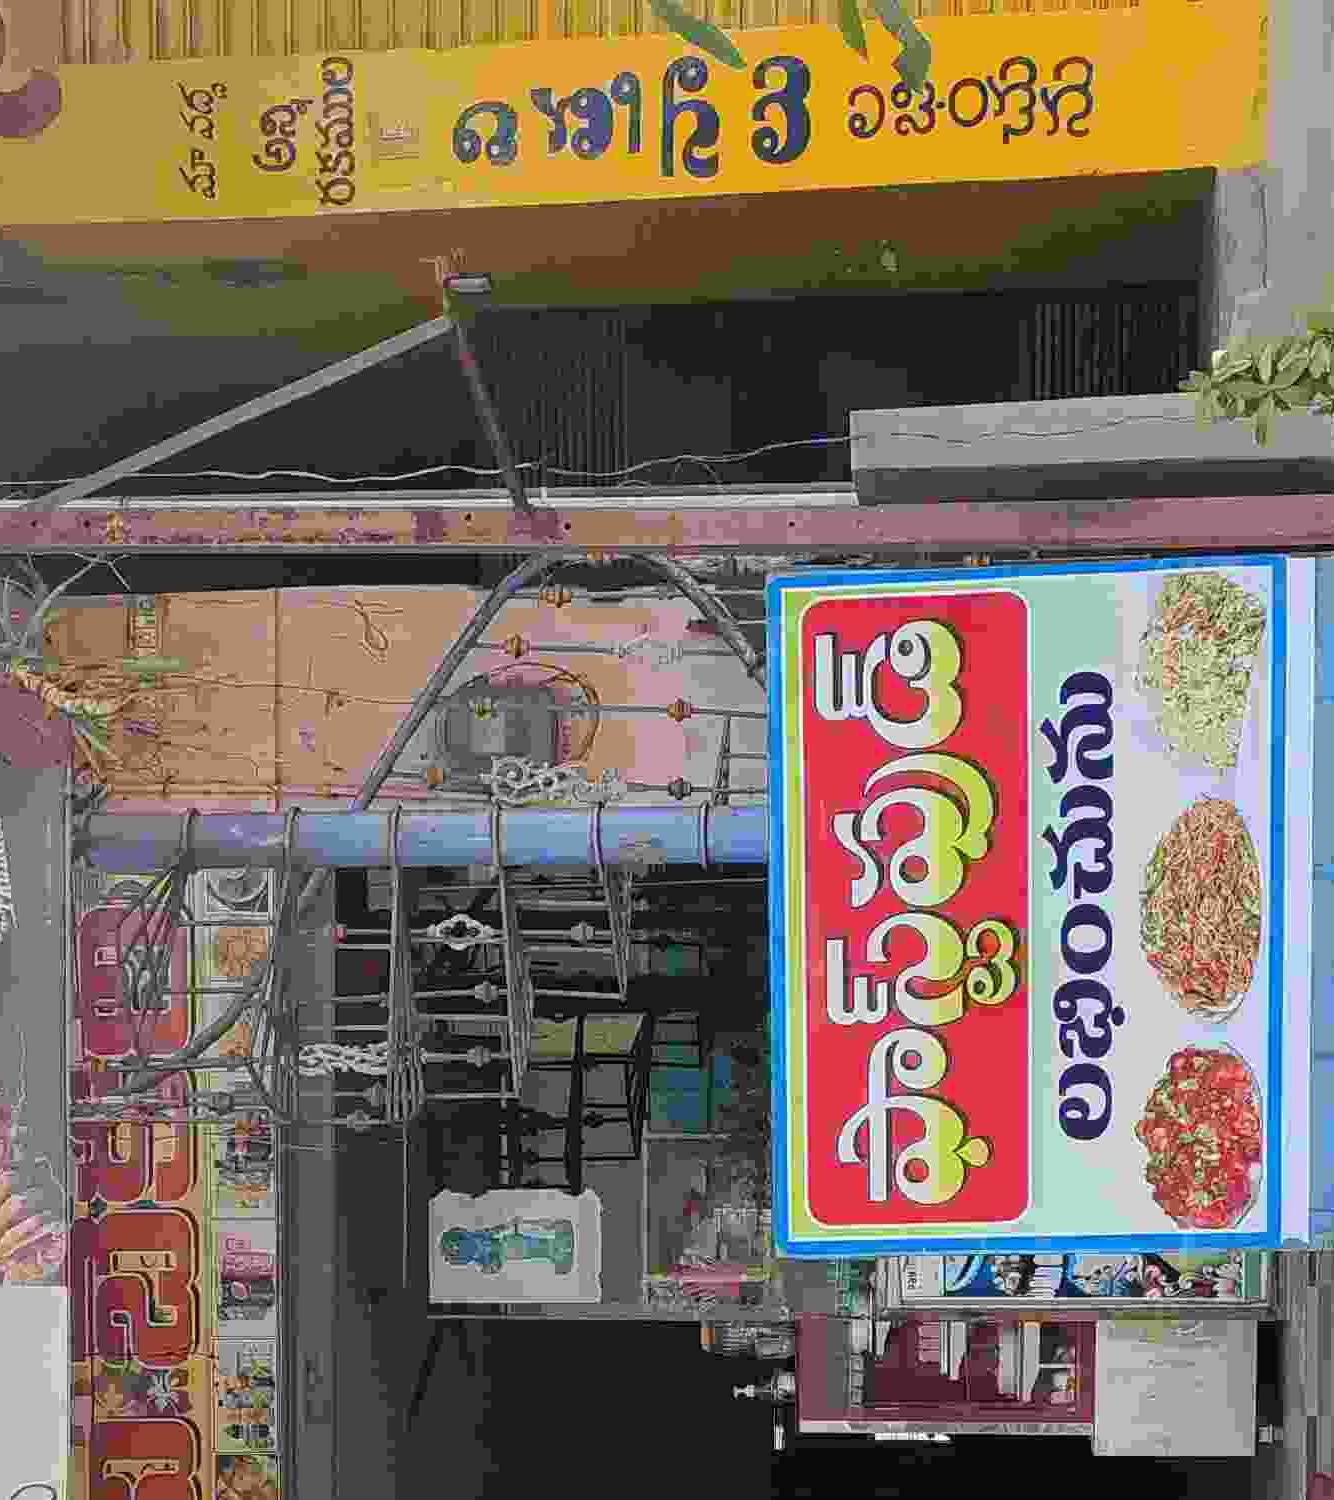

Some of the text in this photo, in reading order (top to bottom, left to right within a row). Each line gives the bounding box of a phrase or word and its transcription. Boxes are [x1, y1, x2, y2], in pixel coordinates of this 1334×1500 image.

[176, 81, 227, 200] మా వద్ద
[251, 98, 313, 172] అన్ని
[314, 56, 356, 206] రకముల
[1038, 670, 1126, 1143] లభించును
